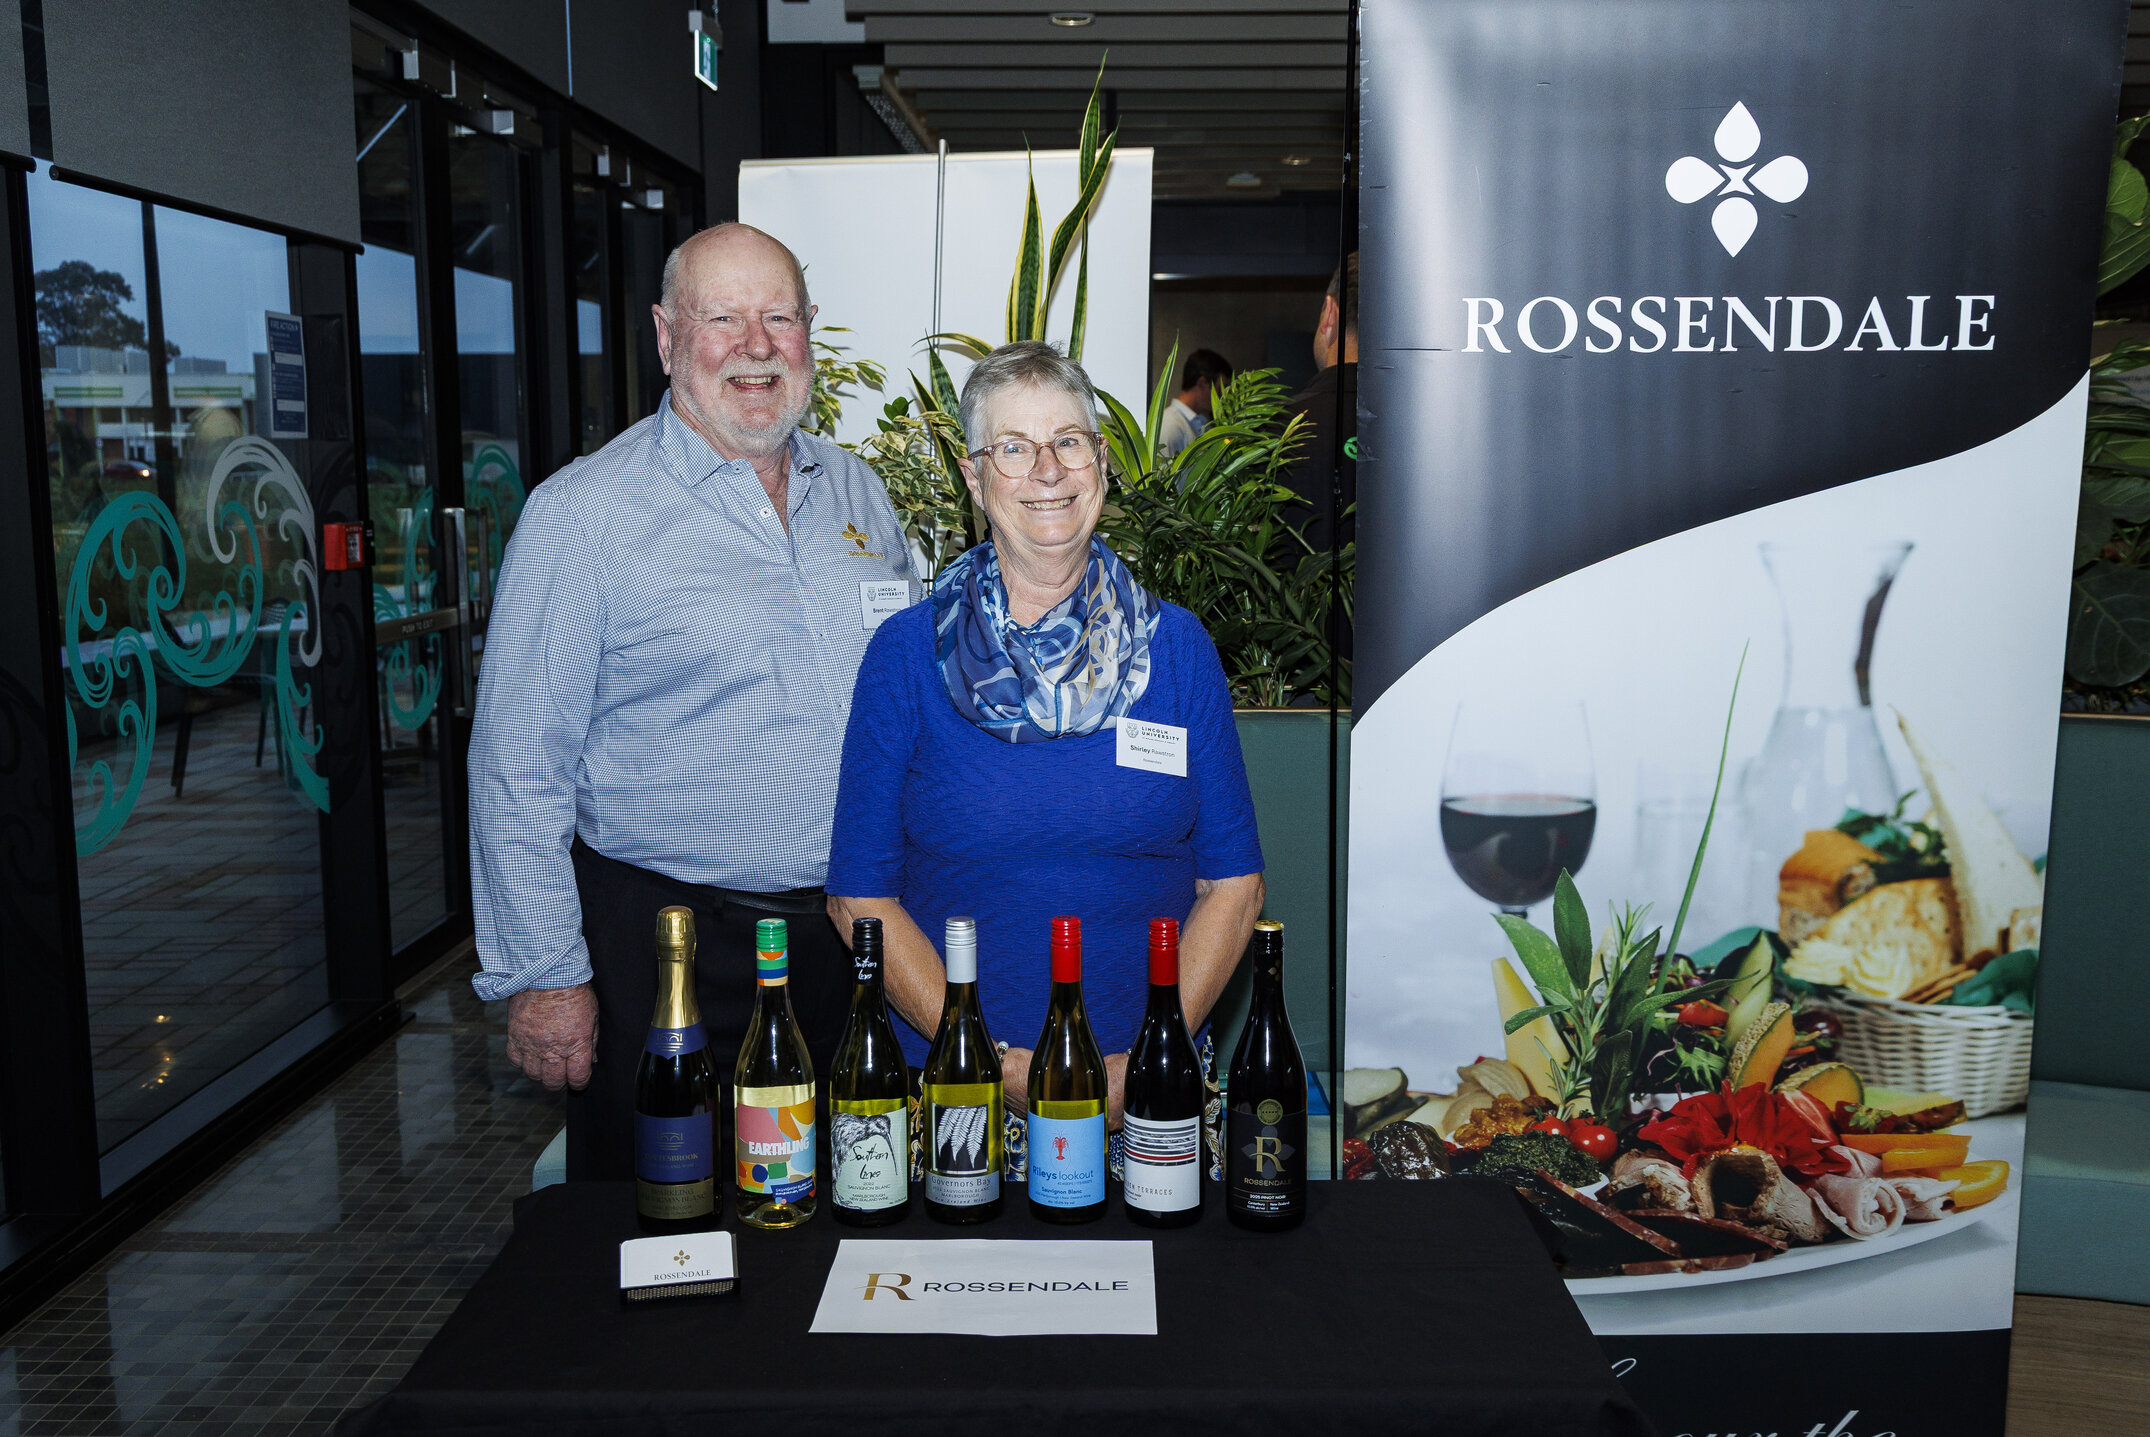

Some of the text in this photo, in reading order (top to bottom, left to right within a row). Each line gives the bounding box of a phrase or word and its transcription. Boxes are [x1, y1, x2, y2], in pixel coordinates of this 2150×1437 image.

[1462, 295, 1997, 353] ROSSENDALE
[1142, 726, 1168, 734] LINCOLN
[1142, 731, 1179, 741] UNIVERSITY
[1130, 745, 1150, 754] Shirley
[749, 1136, 810, 1156] EARTHLING
[850, 1143, 888, 1162] Southern
[1250, 1136, 1286, 1172] R
[1033, 1165, 1093, 1180] Rileys lookout
[932, 1176, 991, 1187] Governors Bay
[1244, 1177, 1292, 1187] ROSSENDALE
[1041, 1187, 1066, 1195] Sauvignon
[1137, 1185, 1173, 1196] TERRACES
[654, 1269, 711, 1281] ROSSENDALE
[854, 1273, 1129, 1300] R ROSSENDALE
